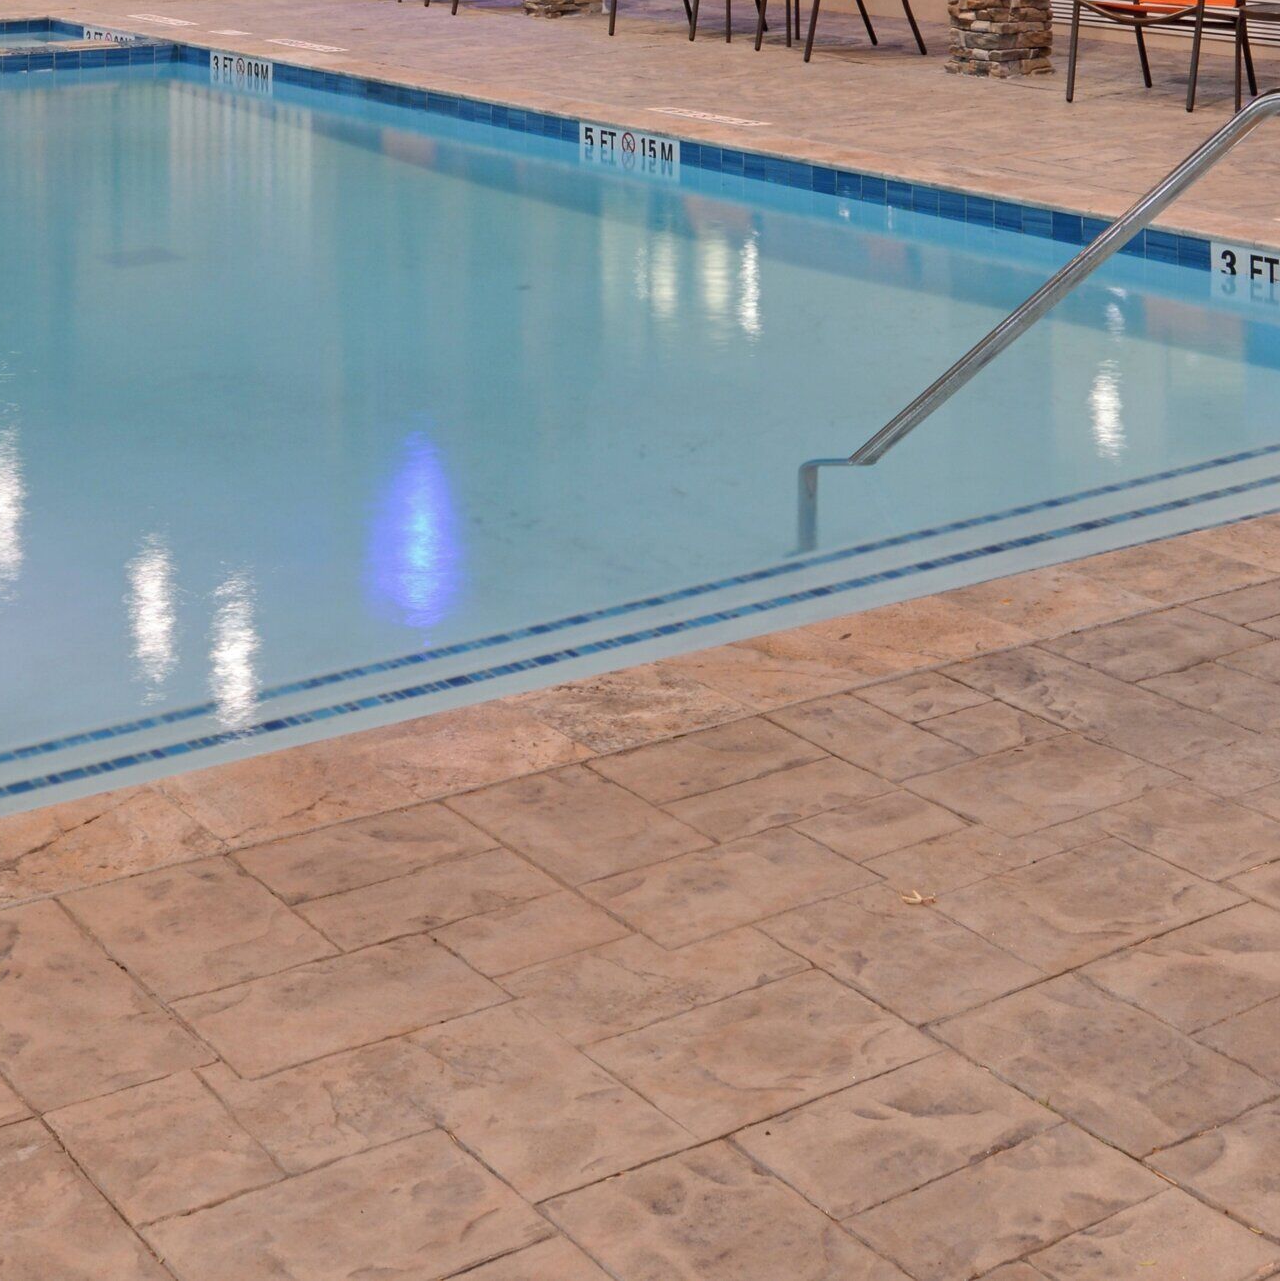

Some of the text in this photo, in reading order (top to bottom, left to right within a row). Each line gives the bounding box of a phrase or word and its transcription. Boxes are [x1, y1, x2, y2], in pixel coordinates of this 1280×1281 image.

[213, 55, 219, 70] 3
[223, 56, 234, 73] FT
[584, 127, 594, 146] 5
[600, 130, 616, 150] FT
[1221, 250, 1237, 275] 3
[1250, 255, 1280, 283] FT
